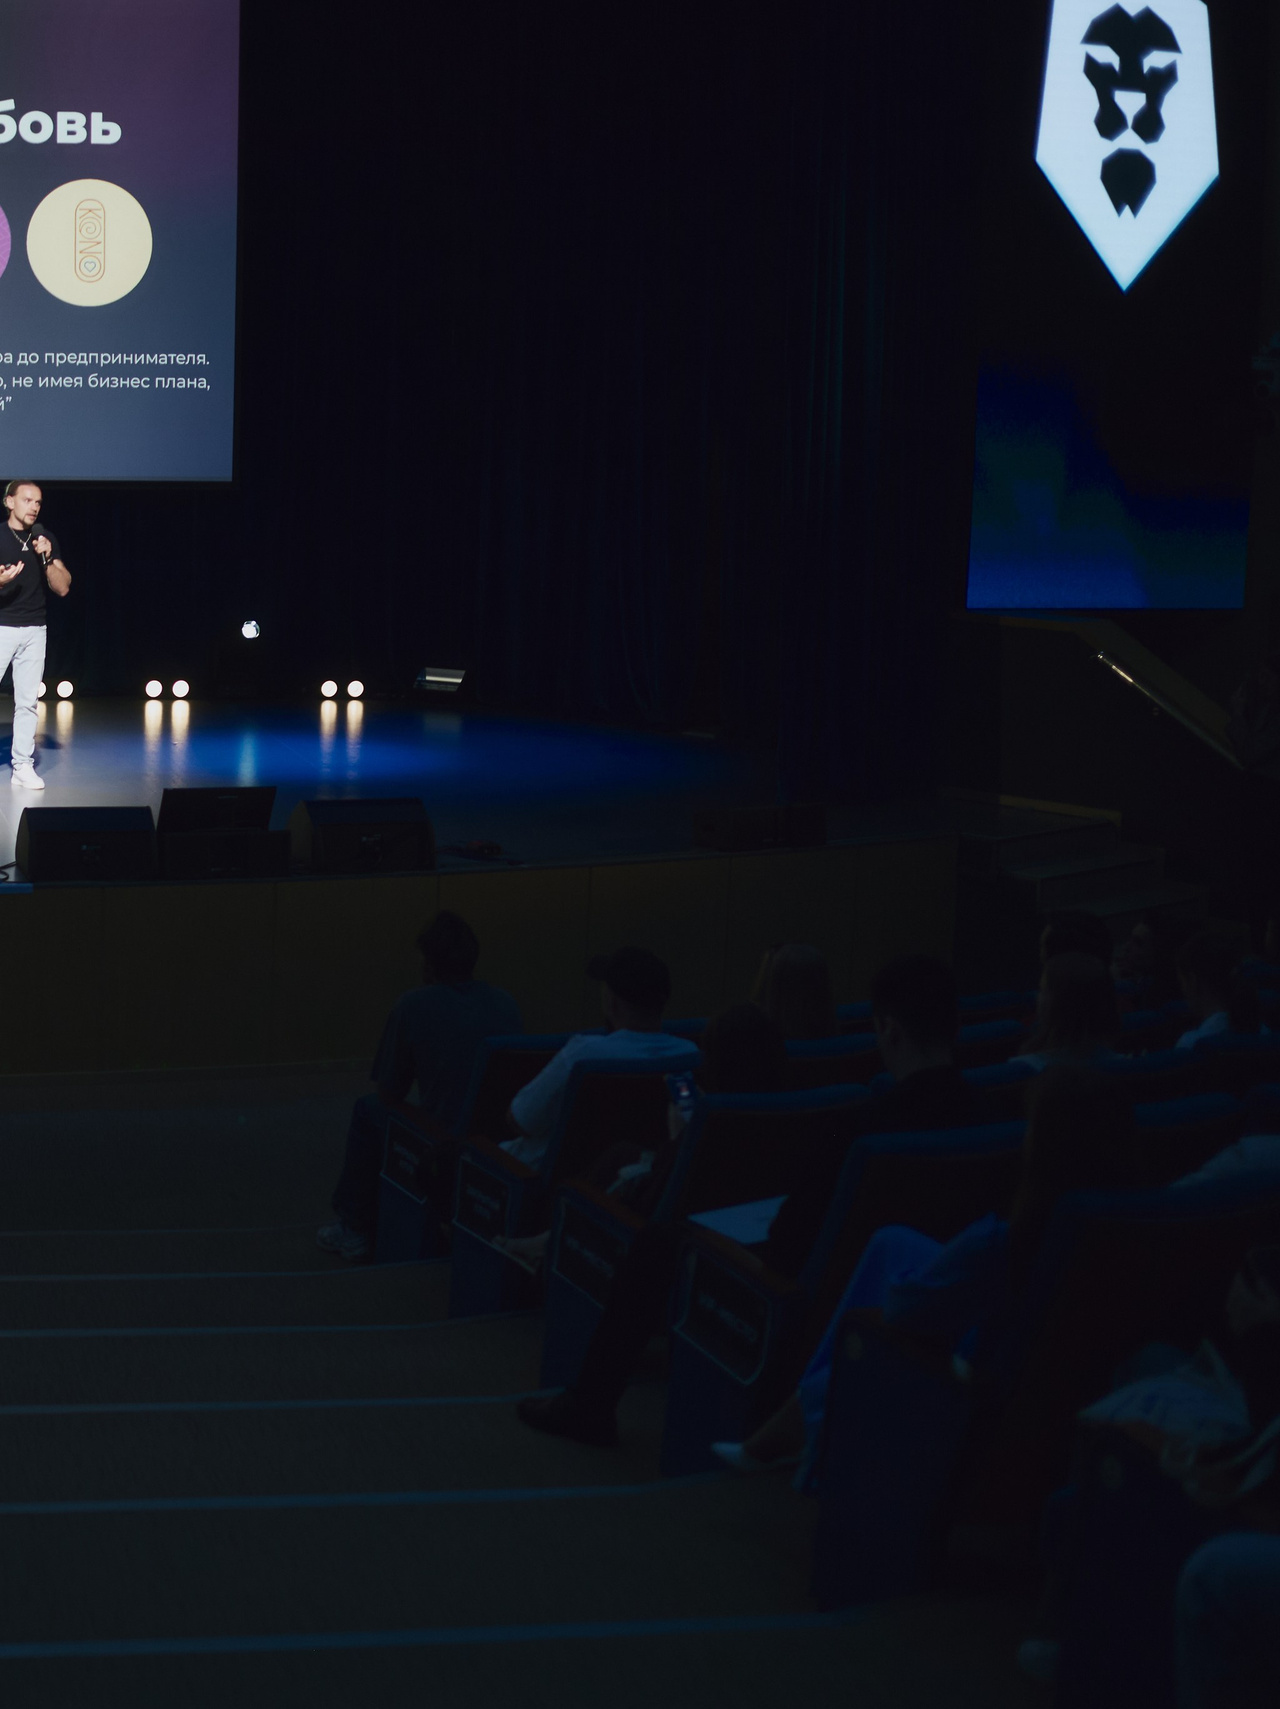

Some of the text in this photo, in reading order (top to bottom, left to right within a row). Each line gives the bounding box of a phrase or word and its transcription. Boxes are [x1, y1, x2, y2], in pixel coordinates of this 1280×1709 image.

[16, 352, 40, 367] до
[44, 352, 210, 368] предпринимателя.
[12, 376, 34, 388] не
[38, 376, 83, 388] имея
[87, 373, 151, 389] бизнес
[155, 376, 211, 392] плана,
